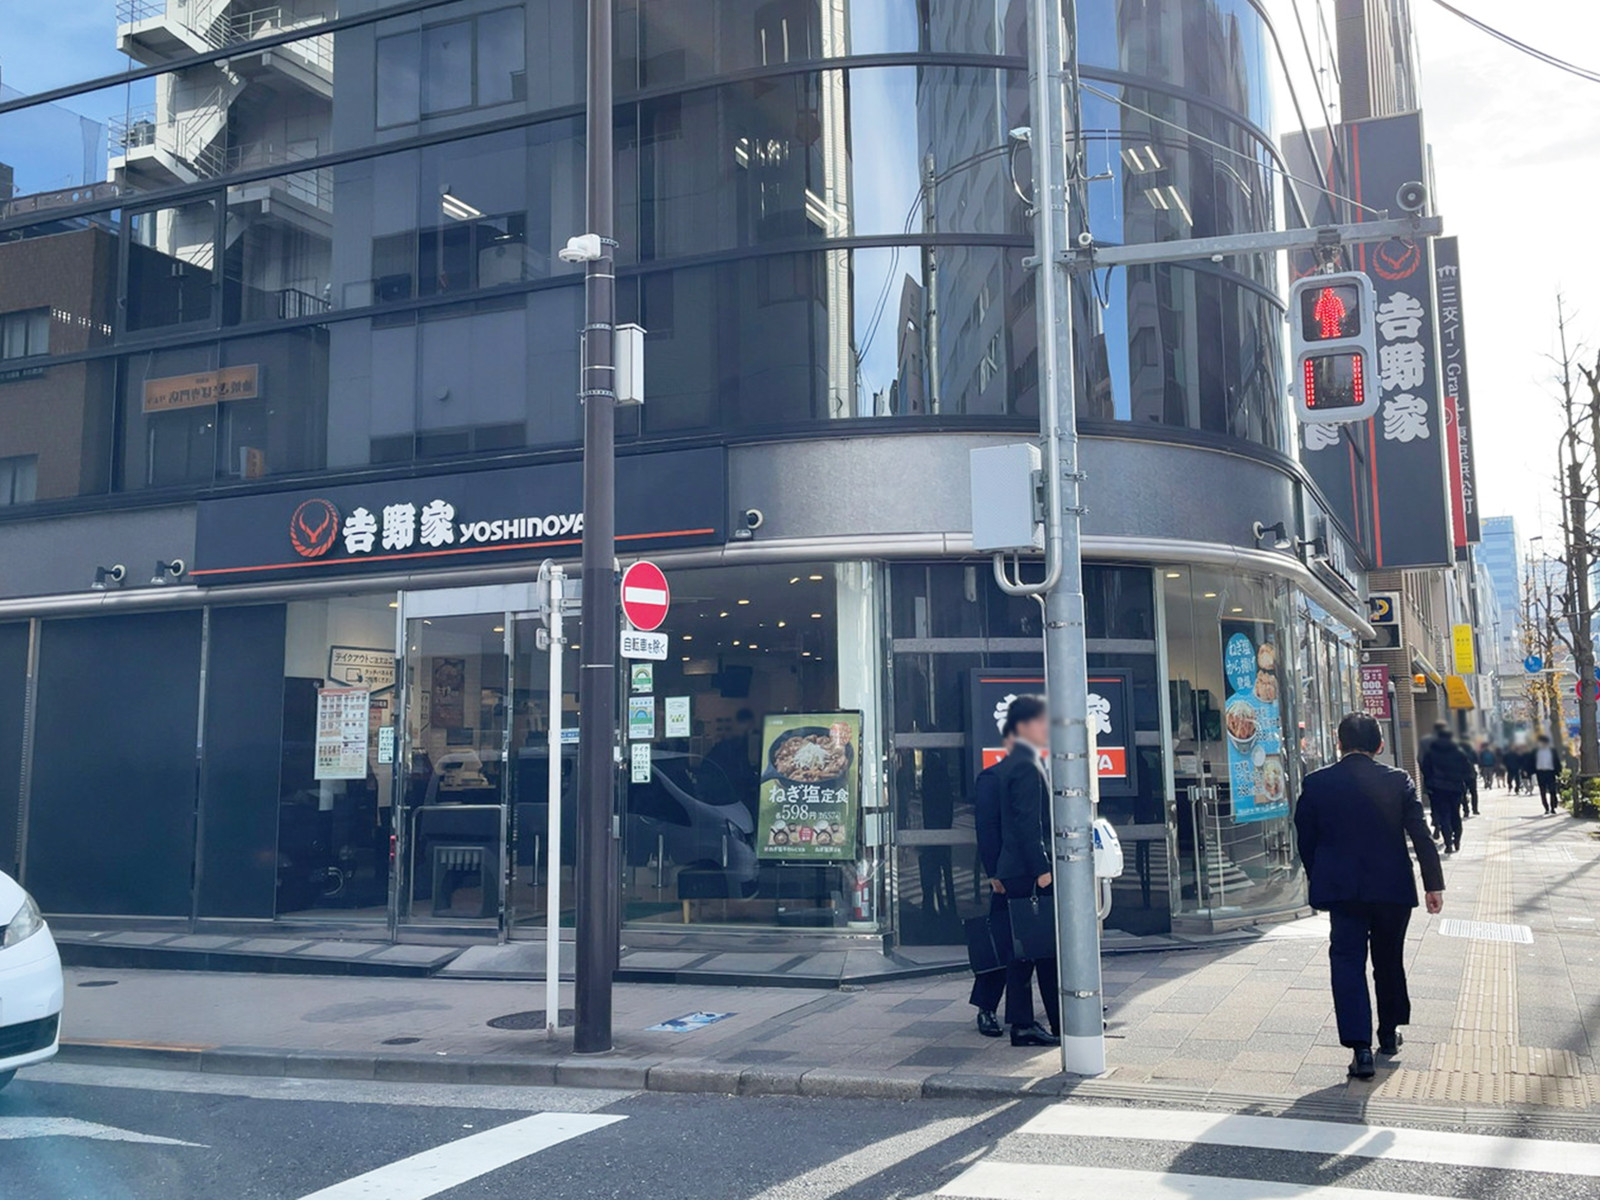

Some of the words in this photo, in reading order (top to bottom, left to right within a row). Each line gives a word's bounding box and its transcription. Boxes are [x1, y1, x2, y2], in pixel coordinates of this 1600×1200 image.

[1375, 291, 1431, 443] 吉野家
[342, 499, 455, 553] 吉野家
[623, 636, 666, 655] 自転車を除く
[769, 784, 849, 804] ねぎ塩定食
